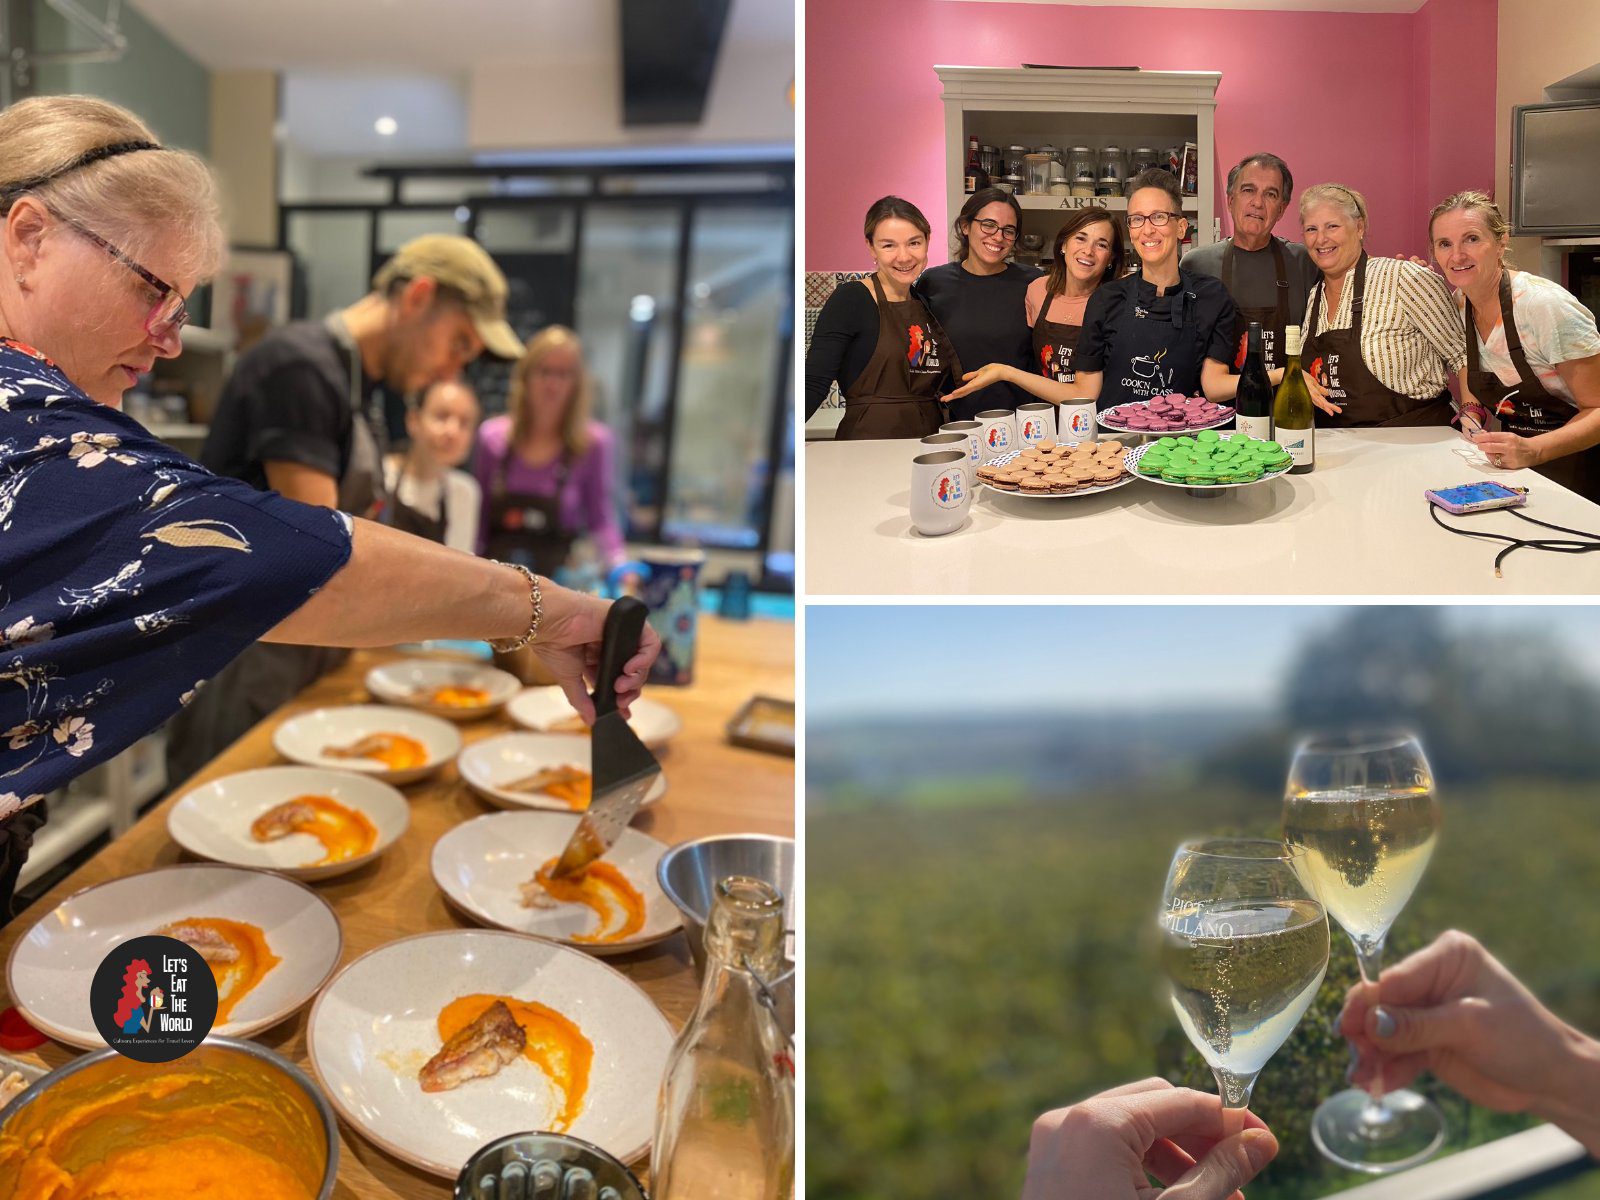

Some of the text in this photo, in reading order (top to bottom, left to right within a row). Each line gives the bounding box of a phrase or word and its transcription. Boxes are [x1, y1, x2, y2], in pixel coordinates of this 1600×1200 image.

[1059, 197, 1108, 209] ARTS
[1261, 329, 1274, 340] LET'S
[1265, 340, 1274, 350] EAT
[1058, 345, 1073, 357] LET'S
[1132, 387, 1174, 397] WITH CLASS
[1171, 897, 1205, 918] PIOT
